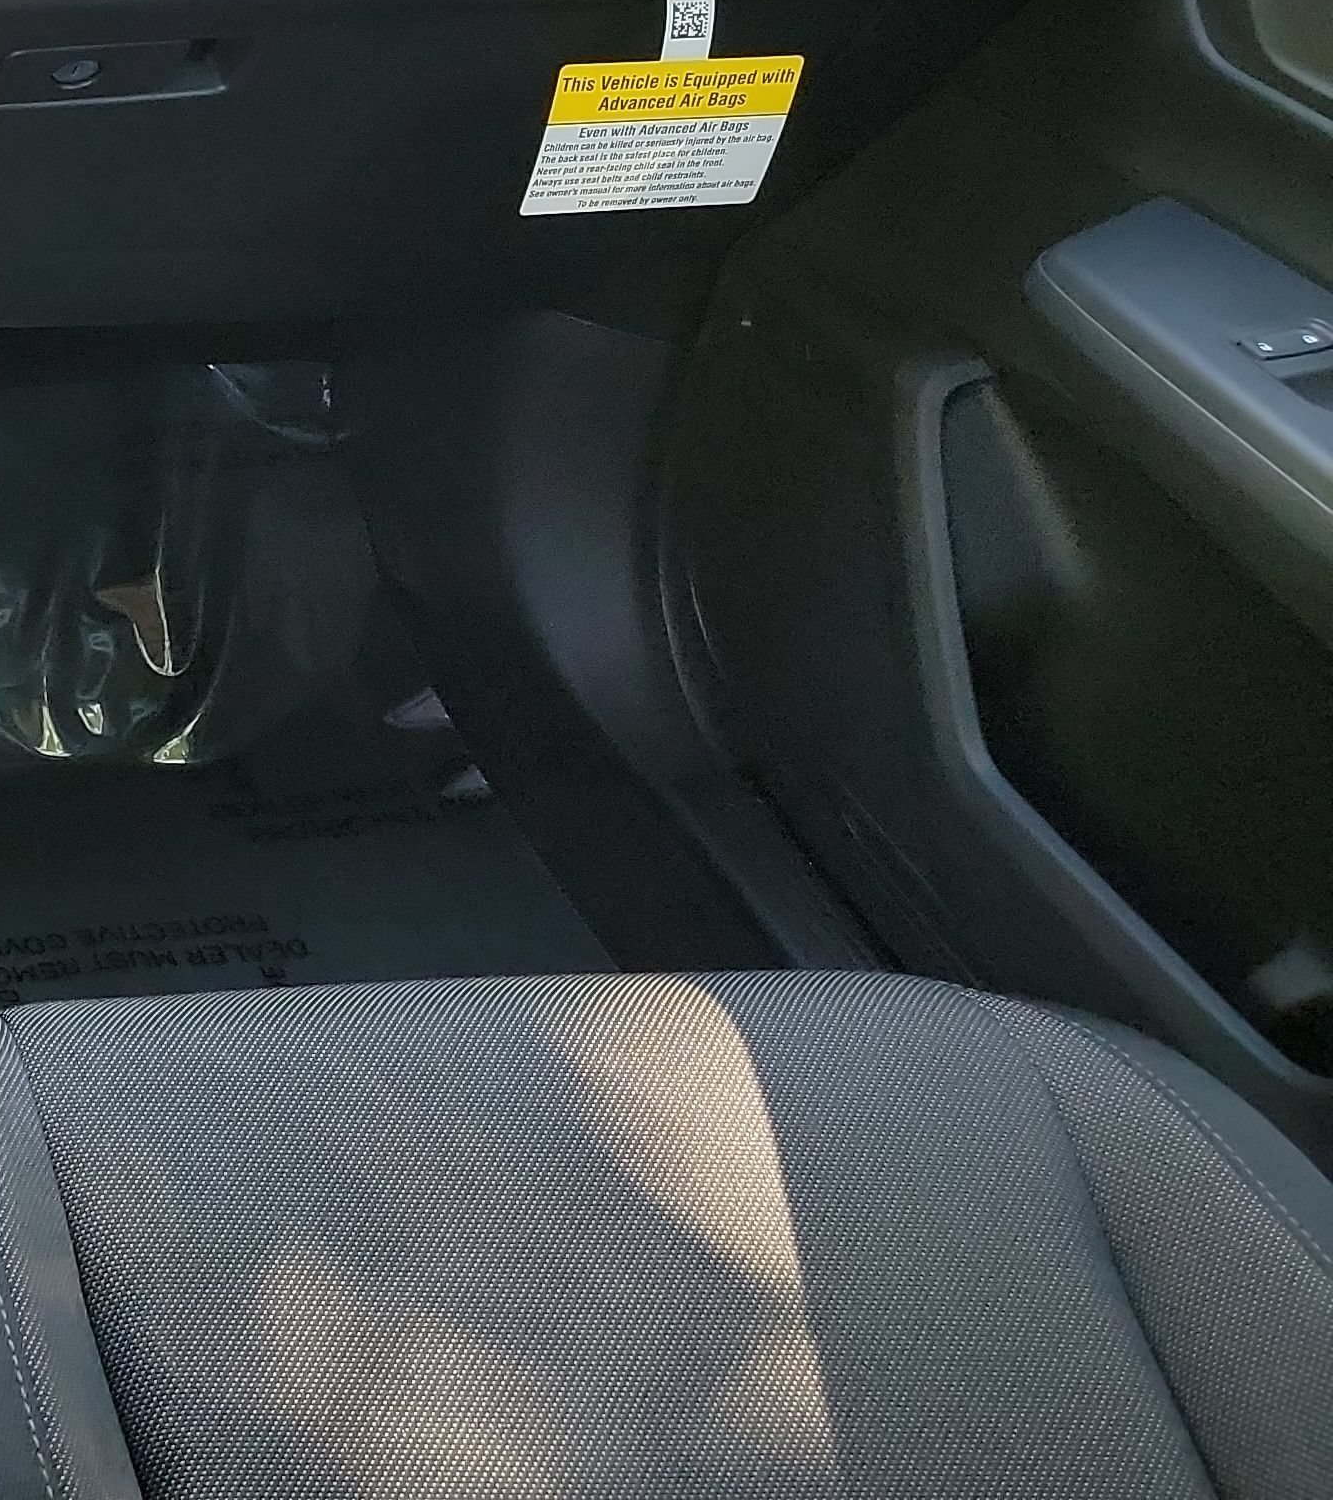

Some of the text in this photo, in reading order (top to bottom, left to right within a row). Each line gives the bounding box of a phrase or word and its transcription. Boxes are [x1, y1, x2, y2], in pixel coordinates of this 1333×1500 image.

[563, 68, 795, 92] This Vehicle is Equipped with
[597, 92, 747, 111] Advanced Air Bags
[579, 121, 750, 138] Even with Advanced Air Bags
[544, 143, 579, 152] Children
[597, 142, 608, 150] be
[610, 140, 633, 149] killed
[685, 136, 714, 146] injured
[716, 136, 727, 145] by
[728, 135, 742, 143] the
[541, 156, 557, 164] The
[558, 154, 577, 163] back
[580, 153, 598, 162] seat
[610, 152, 623, 160] the
[625, 151, 651, 160] safest
[653, 150, 675, 160] place
[678, 149, 690, 157] for
[691, 148, 728, 157] children.
[536, 167, 562, 176] Never
[563, 167, 577, 176] put
[586, 164, 632, 173] rear-facing
[633, 162, 655, 171] child
[656, 161, 675, 169] seat
[687, 160, 701, 168] the
